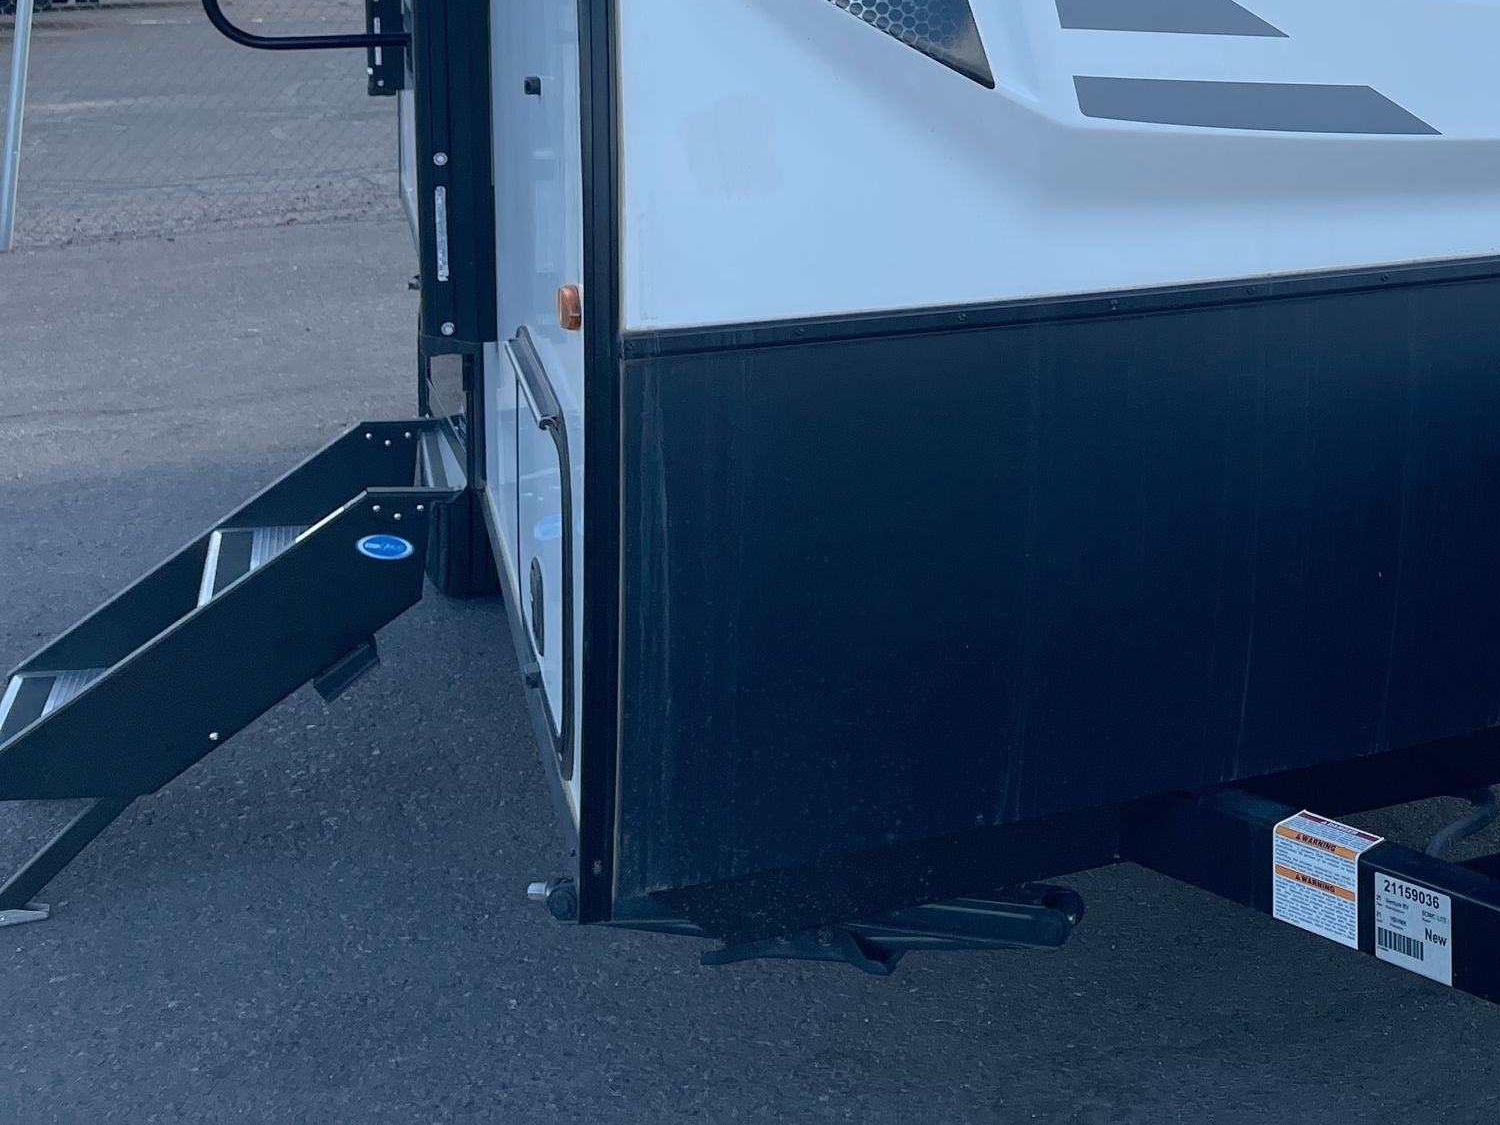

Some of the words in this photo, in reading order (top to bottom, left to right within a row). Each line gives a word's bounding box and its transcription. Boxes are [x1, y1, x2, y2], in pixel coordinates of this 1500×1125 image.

[1301, 834, 1337, 852] WARNING
[1301, 875, 1335, 893] WARNING
[1384, 879, 1440, 909] 21159036
[1424, 927, 1447, 947] New
